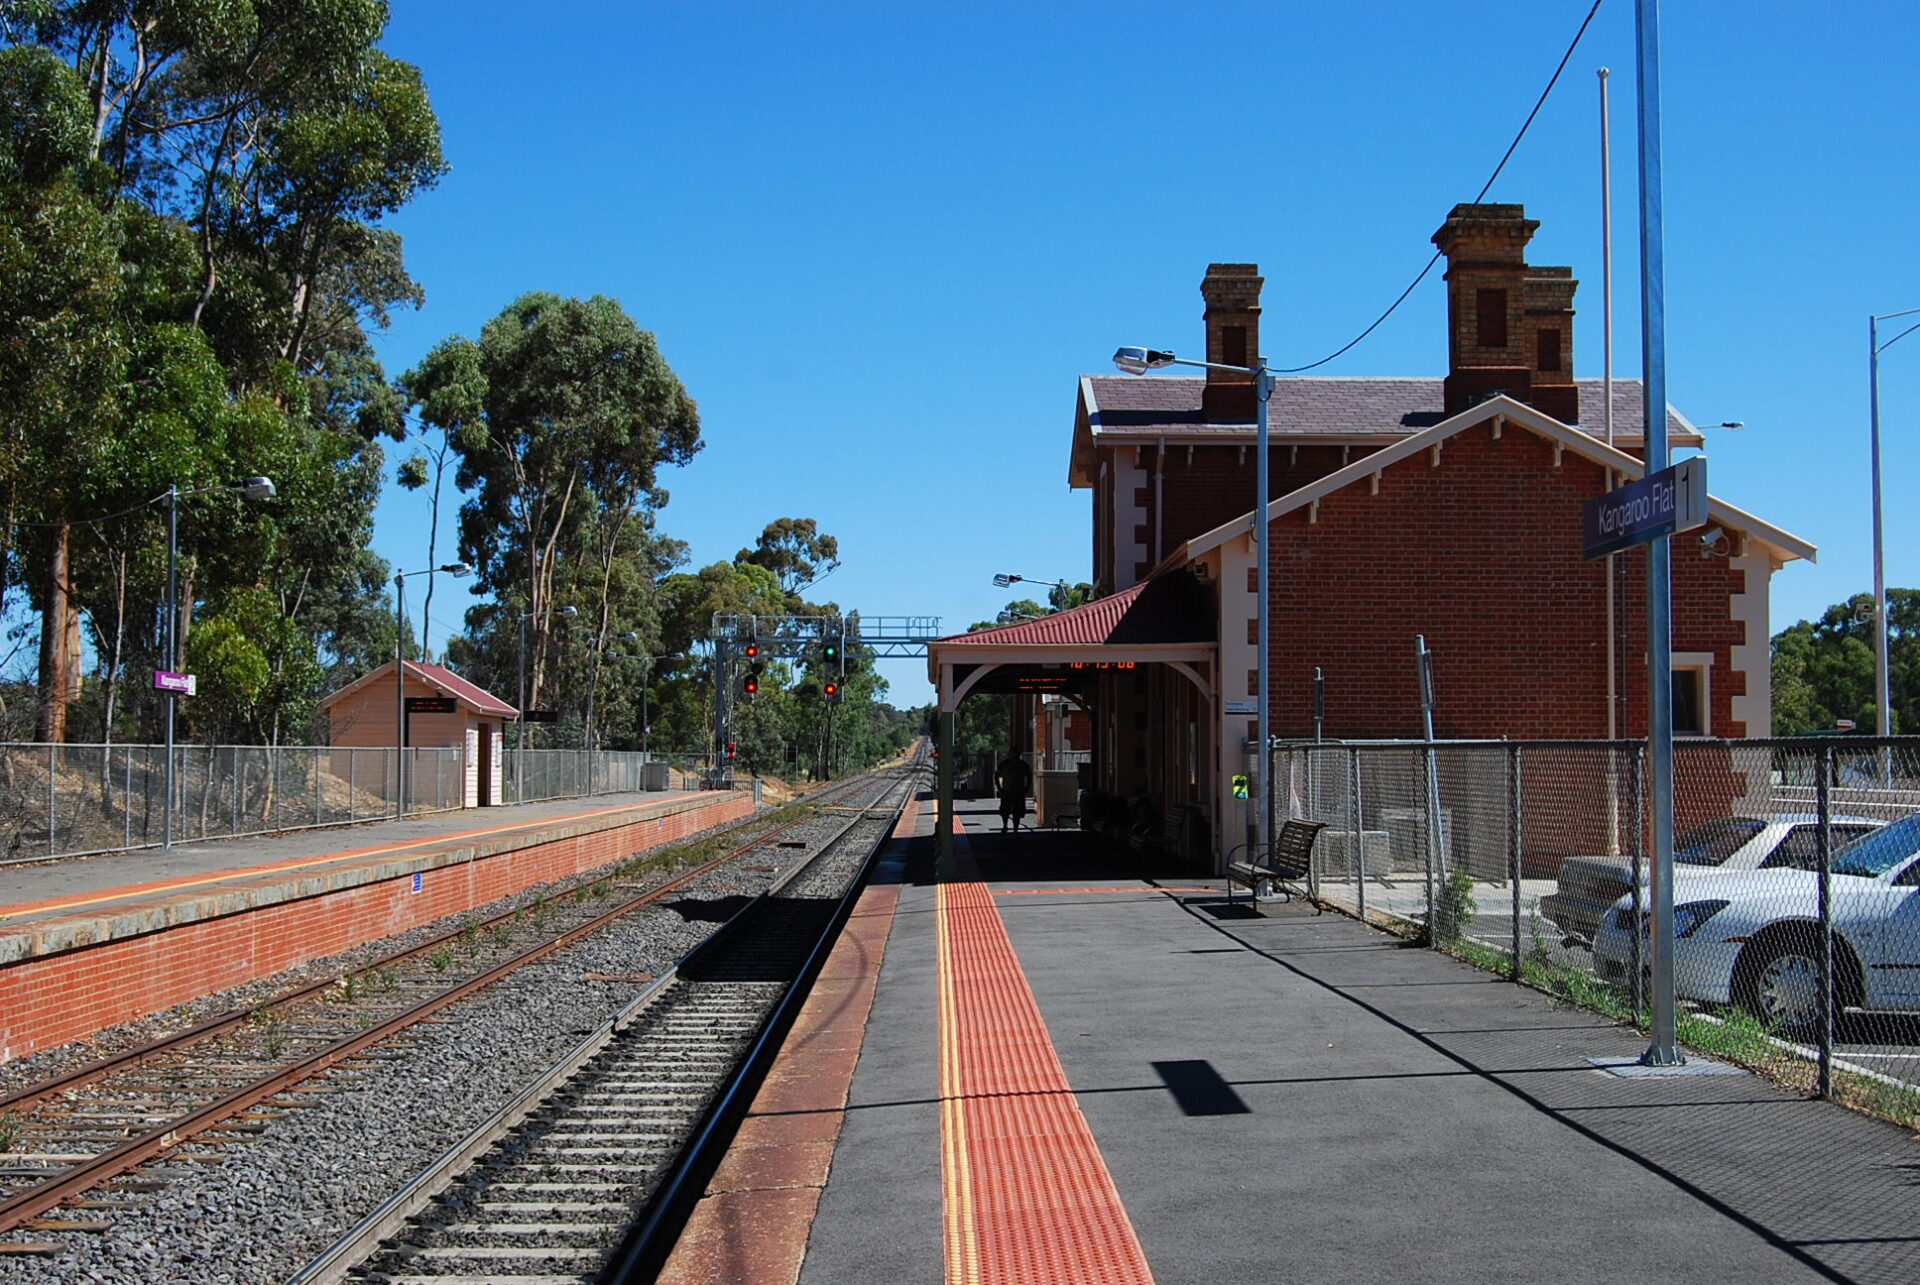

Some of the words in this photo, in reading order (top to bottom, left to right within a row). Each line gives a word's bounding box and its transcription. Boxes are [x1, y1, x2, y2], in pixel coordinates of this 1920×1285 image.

[1598, 496, 1649, 535] Kangaroo
[1652, 479, 1674, 516] Flat
[1681, 466, 1689, 521] 1
